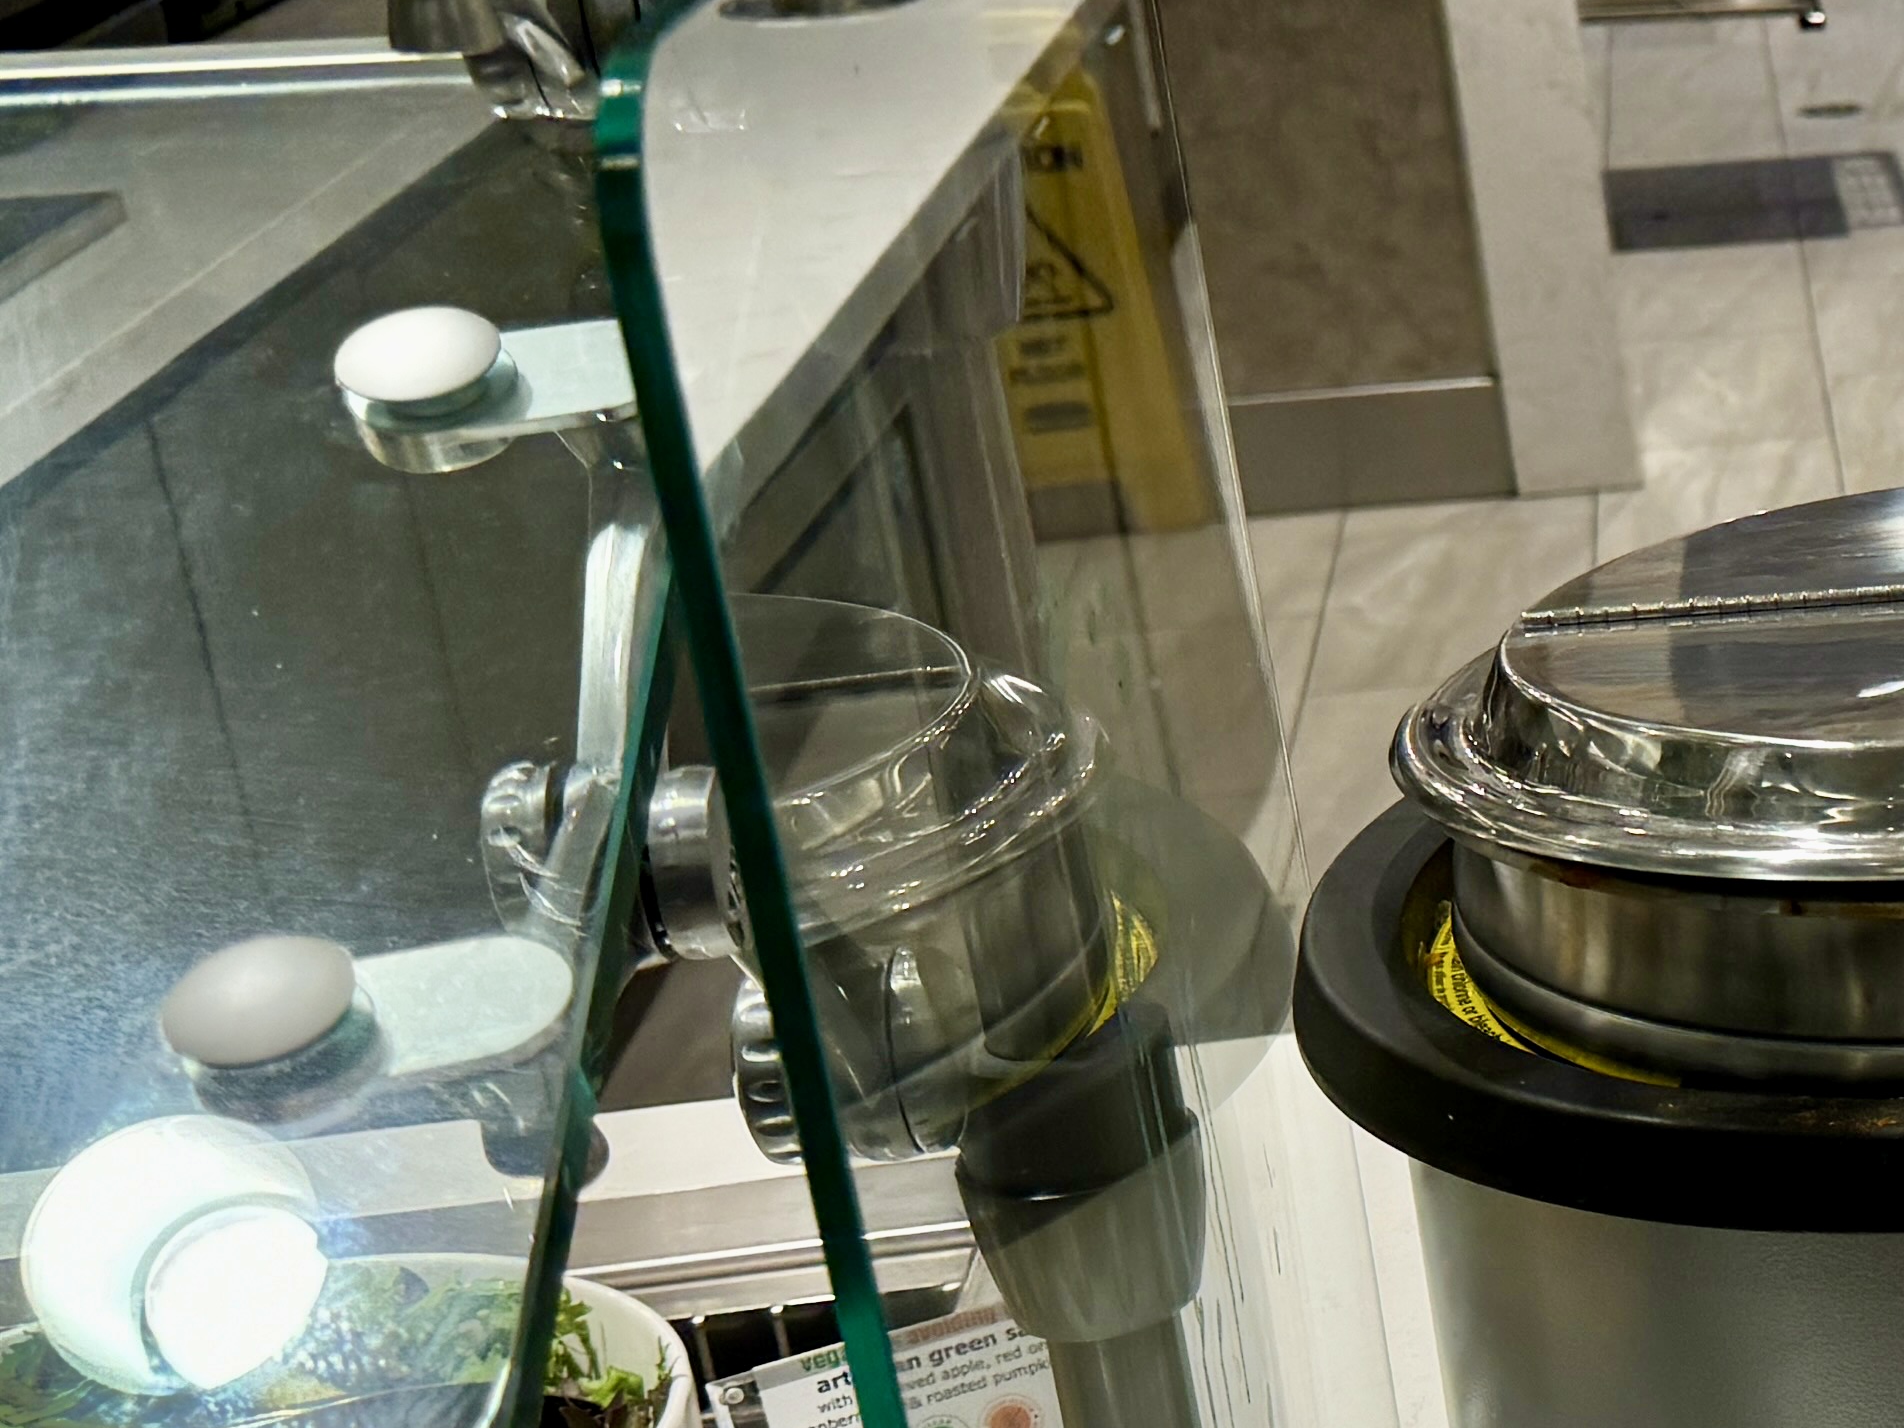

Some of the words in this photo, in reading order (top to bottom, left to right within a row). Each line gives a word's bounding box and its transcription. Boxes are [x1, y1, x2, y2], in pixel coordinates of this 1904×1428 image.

[928, 1333, 998, 1367] green
[817, 1394, 853, 1413] with
[995, 1346, 1023, 1365] red
